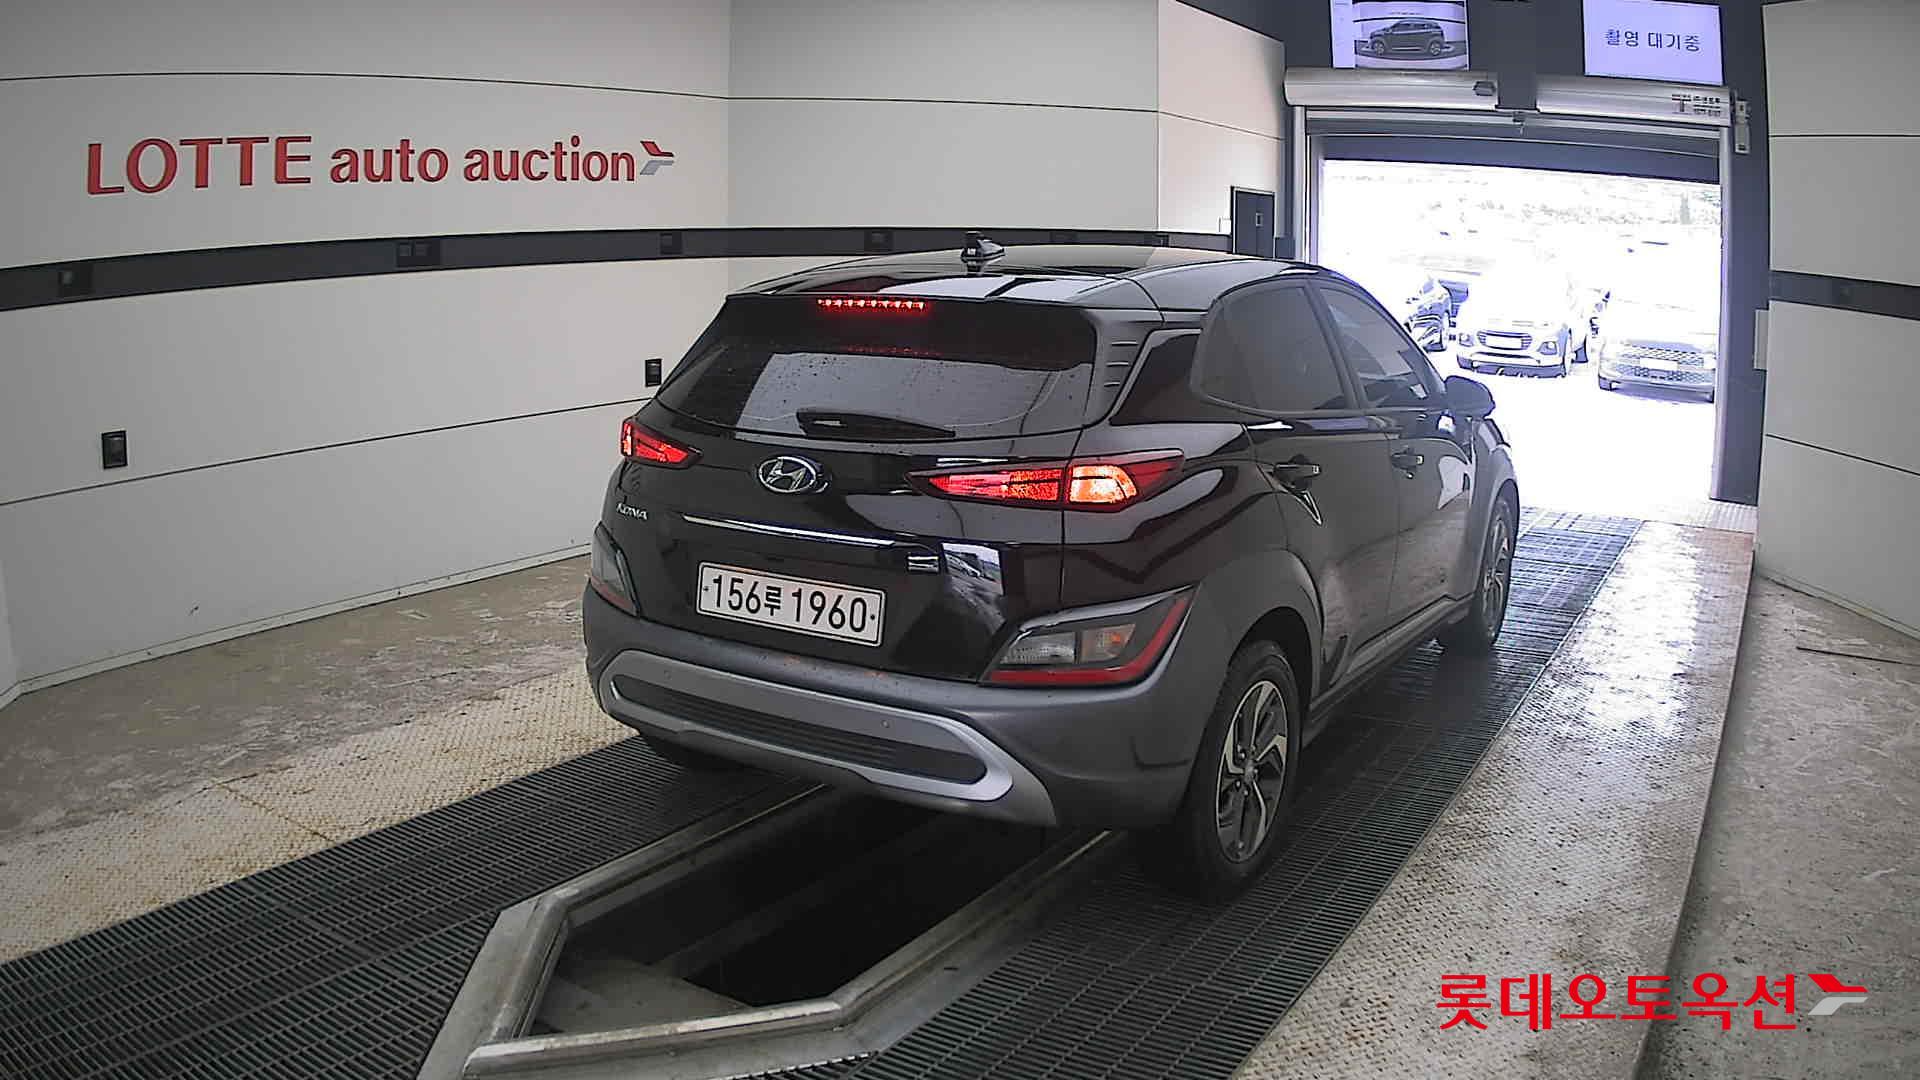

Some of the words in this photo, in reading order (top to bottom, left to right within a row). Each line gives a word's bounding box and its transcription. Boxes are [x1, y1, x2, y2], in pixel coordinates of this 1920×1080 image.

[1647, 31, 1701, 52] 대기중
[87, 135, 312, 195] LOTTE
[329, 138, 449, 183] auto
[463, 135, 636, 182] auction
[791, 587, 868, 633] 1960
